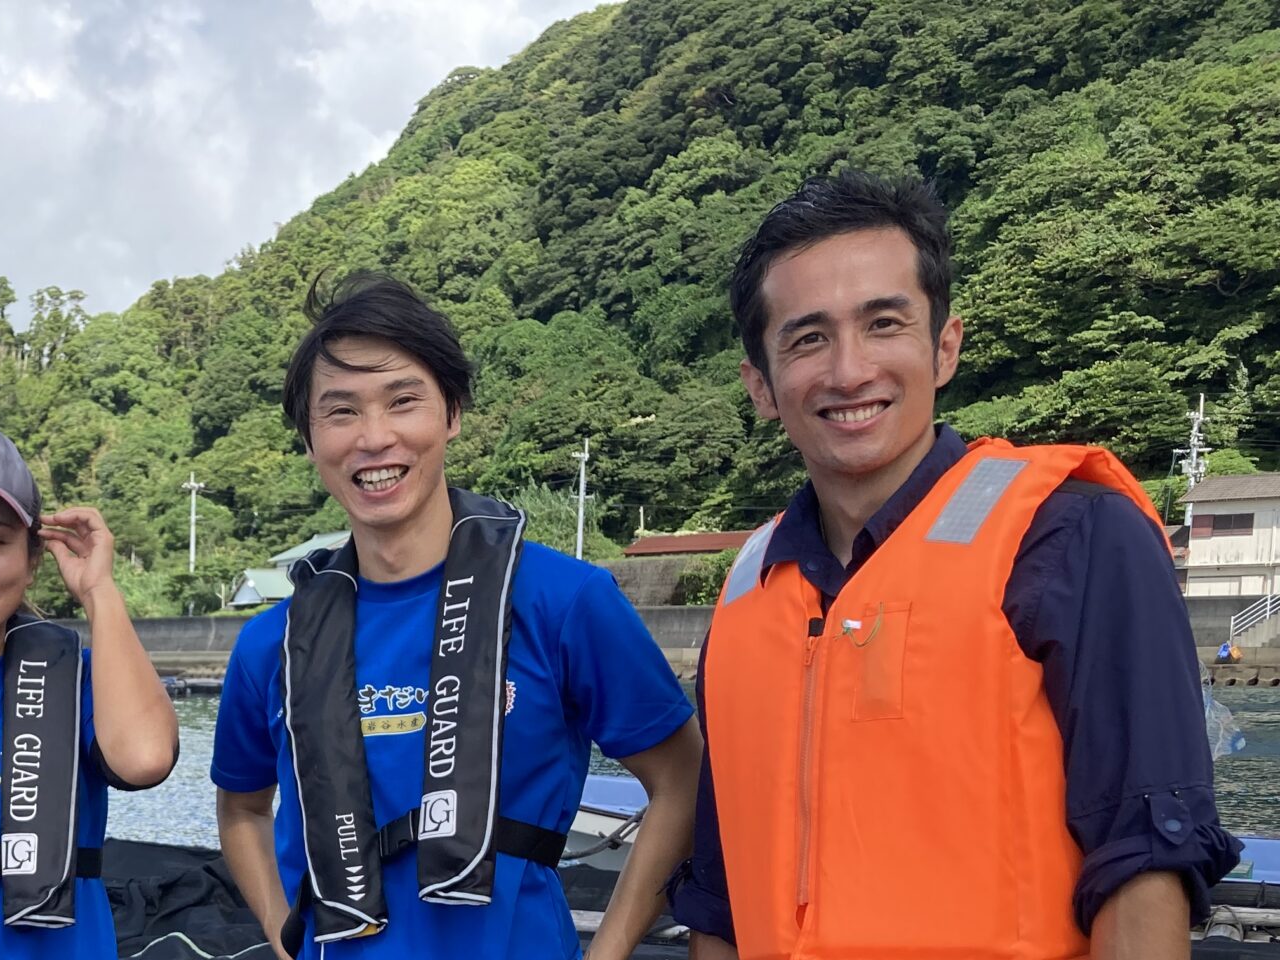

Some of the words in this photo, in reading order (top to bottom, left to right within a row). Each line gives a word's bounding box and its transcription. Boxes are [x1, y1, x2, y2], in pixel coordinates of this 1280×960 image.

[438, 575, 474, 657] LIFE
[15, 659, 48, 719] LIFE
[428, 675, 461, 779] GUARD
[9, 733, 42, 822] GUARD
[335, 812, 359, 861] PULL
